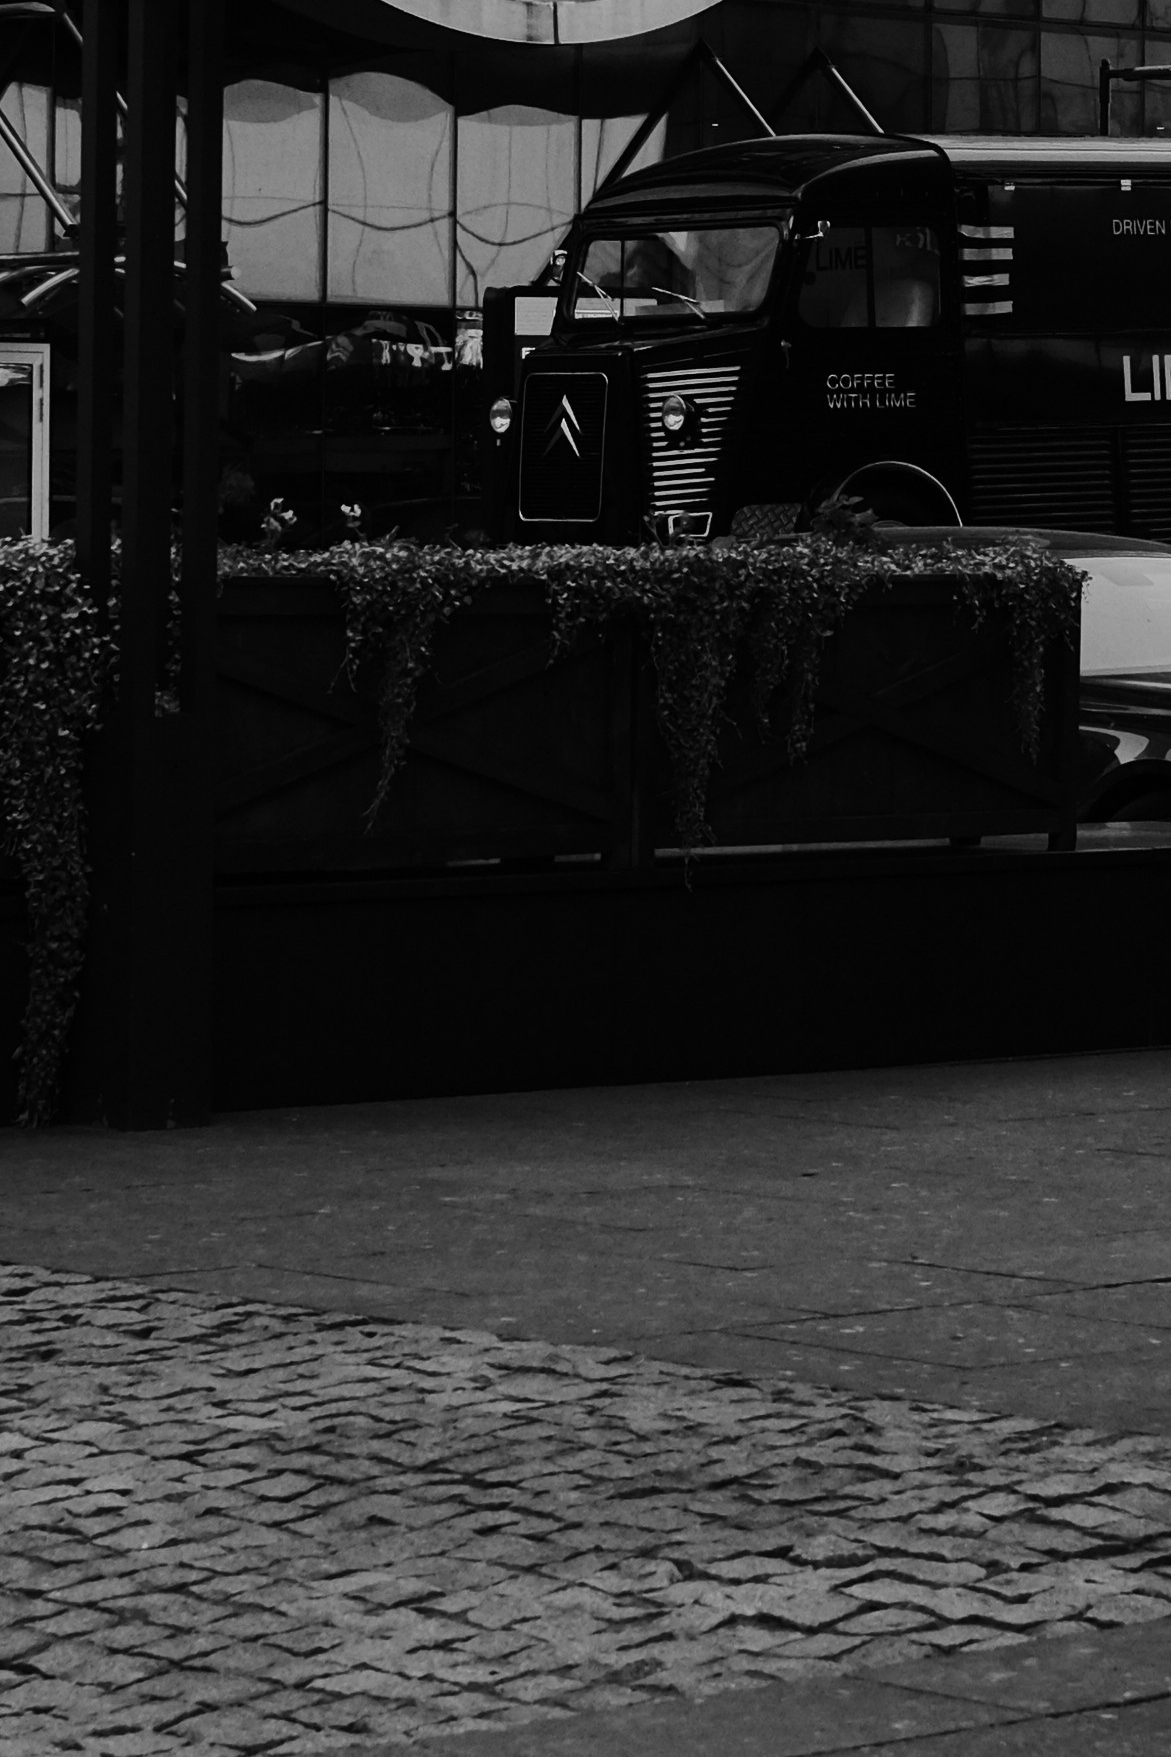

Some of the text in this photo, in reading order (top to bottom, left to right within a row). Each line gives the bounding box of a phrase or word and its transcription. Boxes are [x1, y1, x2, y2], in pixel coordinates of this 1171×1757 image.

[1112, 218, 1167, 236] DRIVEN
[826, 373, 896, 390] COFFEE
[826, 392, 871, 410] WITH
